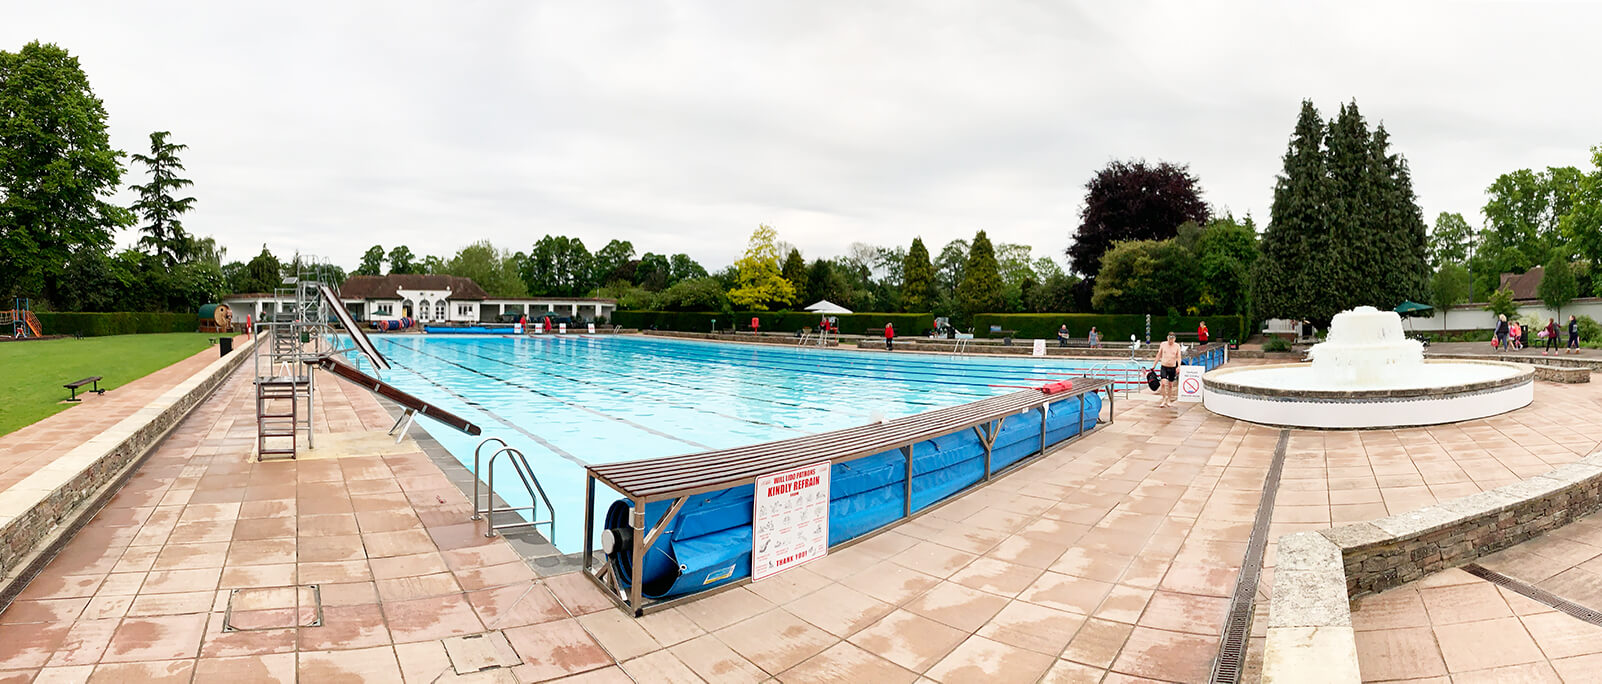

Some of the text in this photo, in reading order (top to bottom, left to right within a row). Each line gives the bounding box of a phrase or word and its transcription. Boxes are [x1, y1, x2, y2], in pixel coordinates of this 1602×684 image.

[797, 468, 816, 479] PATRONS
[768, 476, 819, 497] KINDLY REFRAIN
[776, 555, 793, 567] THANK
